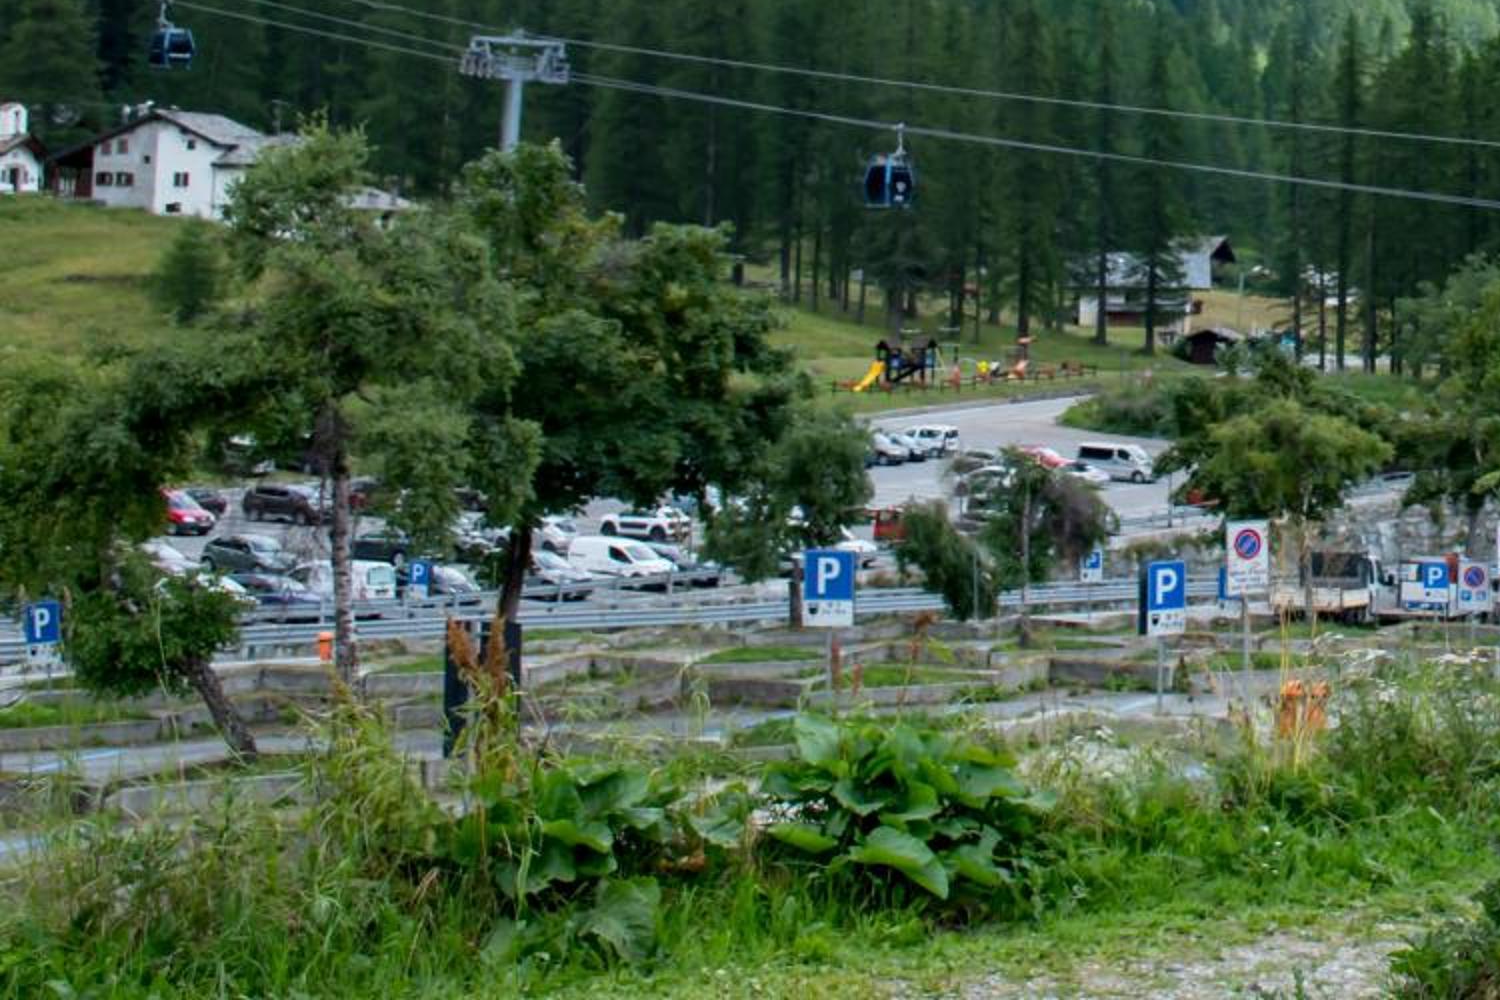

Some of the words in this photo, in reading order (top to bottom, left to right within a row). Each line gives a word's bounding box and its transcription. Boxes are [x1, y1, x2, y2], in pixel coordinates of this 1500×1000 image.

[817, 557, 840, 595] P
[1155, 569, 1177, 605] P
[1427, 567, 1443, 585] P
[34, 607, 50, 639] P
